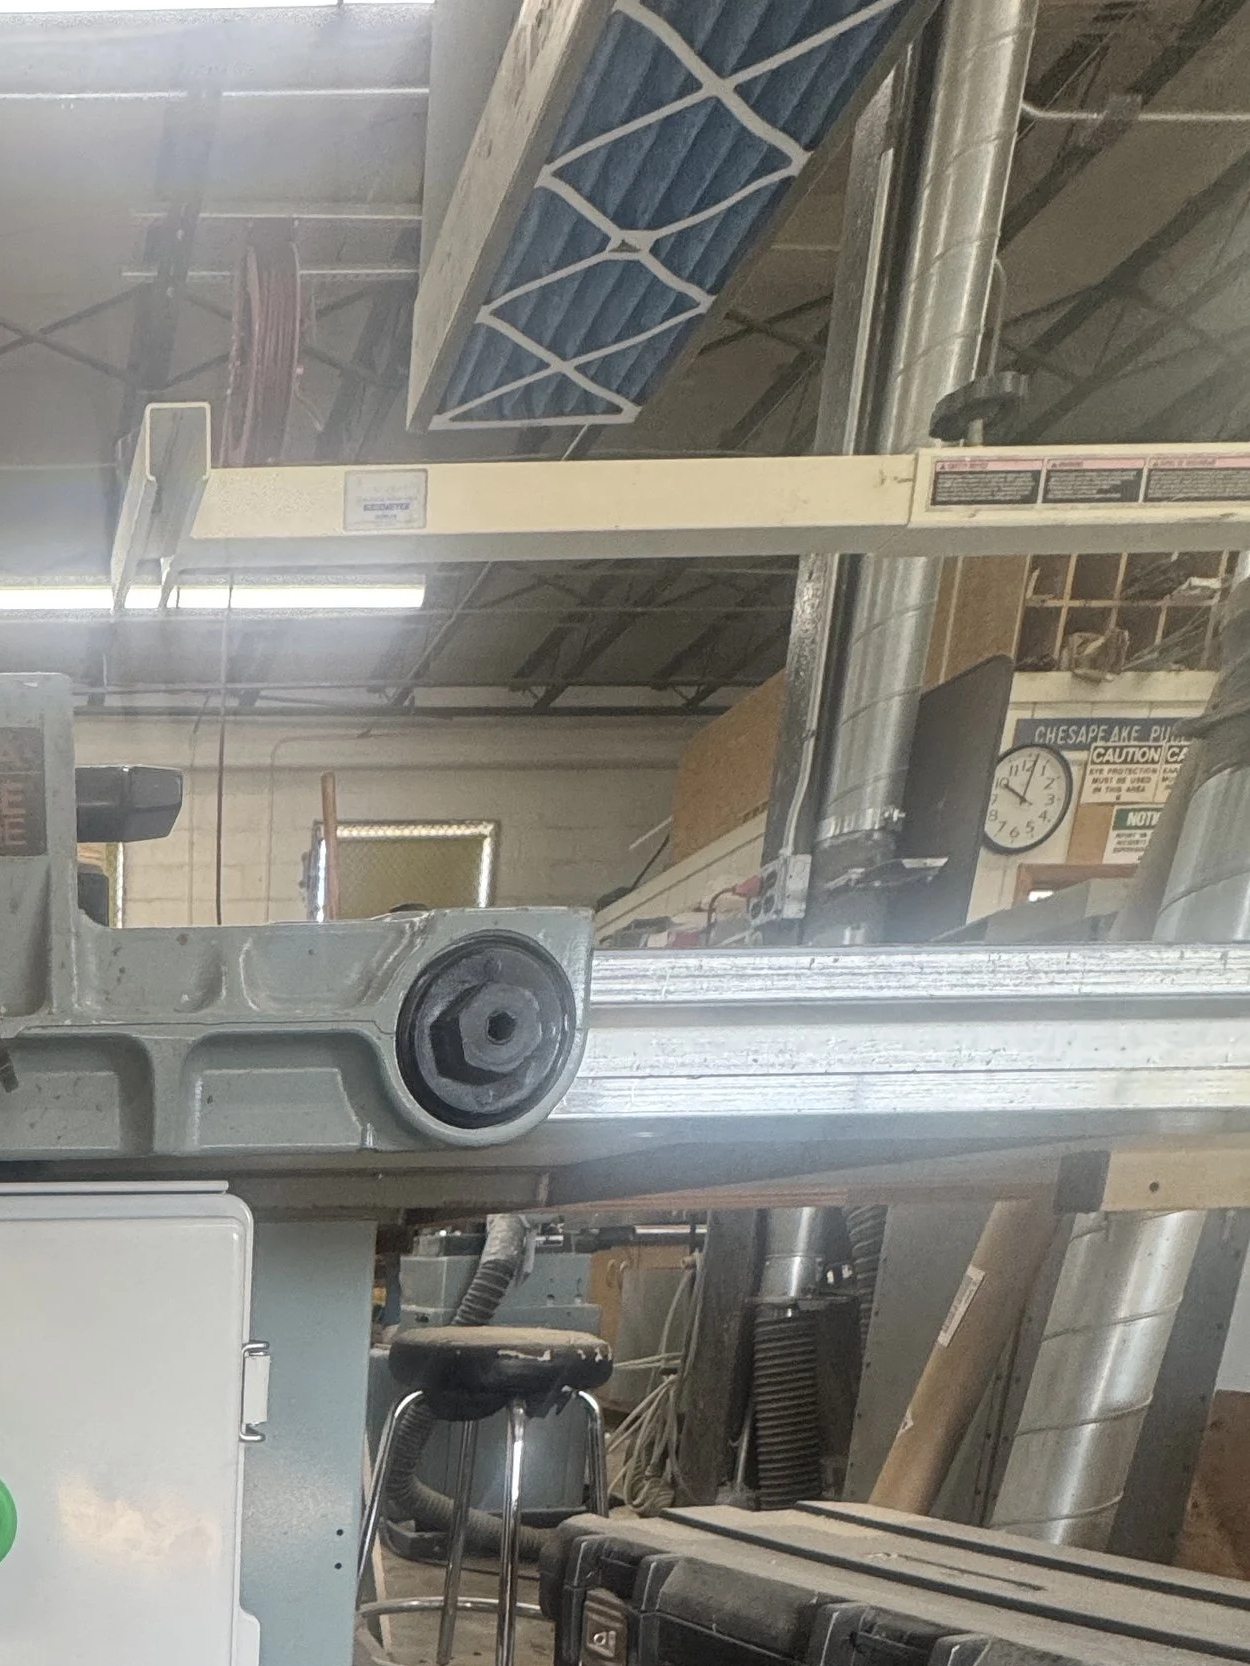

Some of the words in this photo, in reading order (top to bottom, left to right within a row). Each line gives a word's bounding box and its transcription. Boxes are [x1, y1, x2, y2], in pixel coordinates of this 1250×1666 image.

[1092, 747, 1161, 763] CAUTION
[1107, 767, 1158, 775] PROTECTION
[1091, 777, 1113, 785] MUST
[1130, 776, 1152, 784] USED
[1126, 785, 1146, 793] AREA
[1044, 794, 1056, 806] 3
[1038, 810, 1048, 823] 4
[1126, 811, 1162, 827] NOTI
[1009, 826, 1021, 839] 6
[1025, 820, 1036, 834] 5
